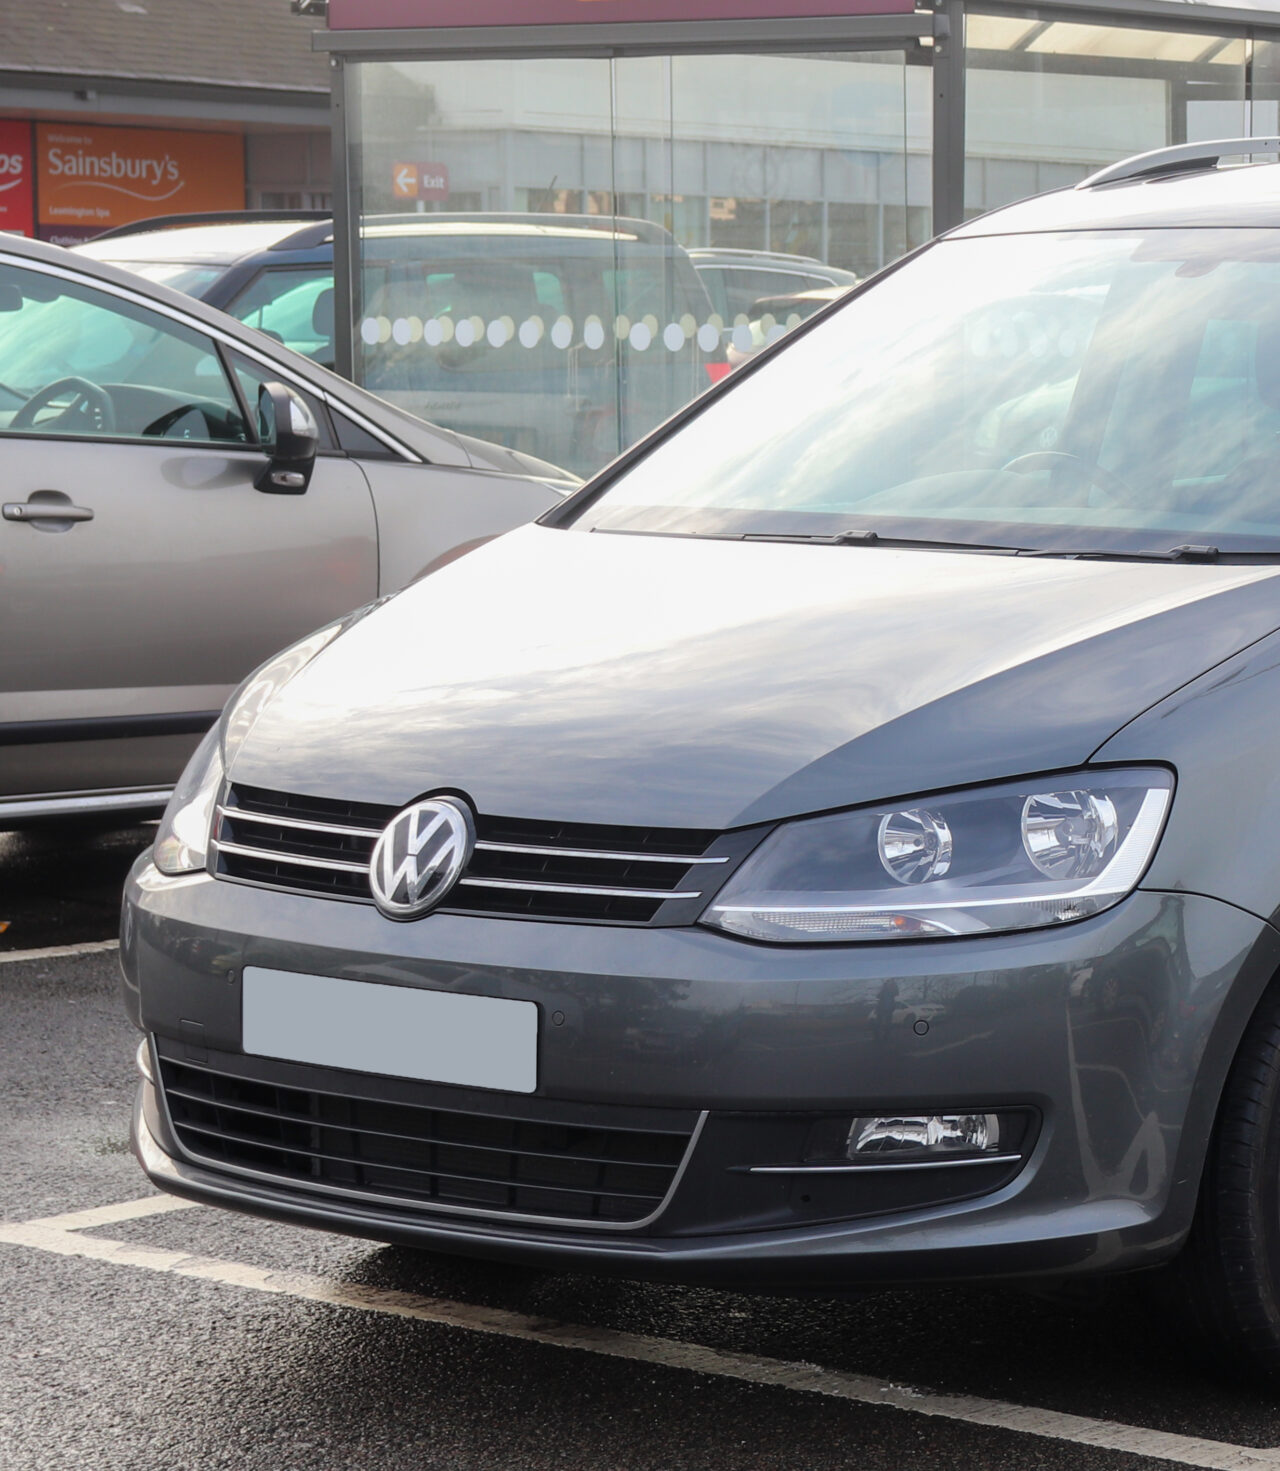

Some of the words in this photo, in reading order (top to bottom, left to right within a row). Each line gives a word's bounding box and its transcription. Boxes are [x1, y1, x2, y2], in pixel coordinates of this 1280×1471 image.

[48, 148, 179, 186] Sainsbury's
[423, 175, 444, 189] Exit
[48, 205, 95, 218] Leamington
[96, 207, 111, 219] Spa
